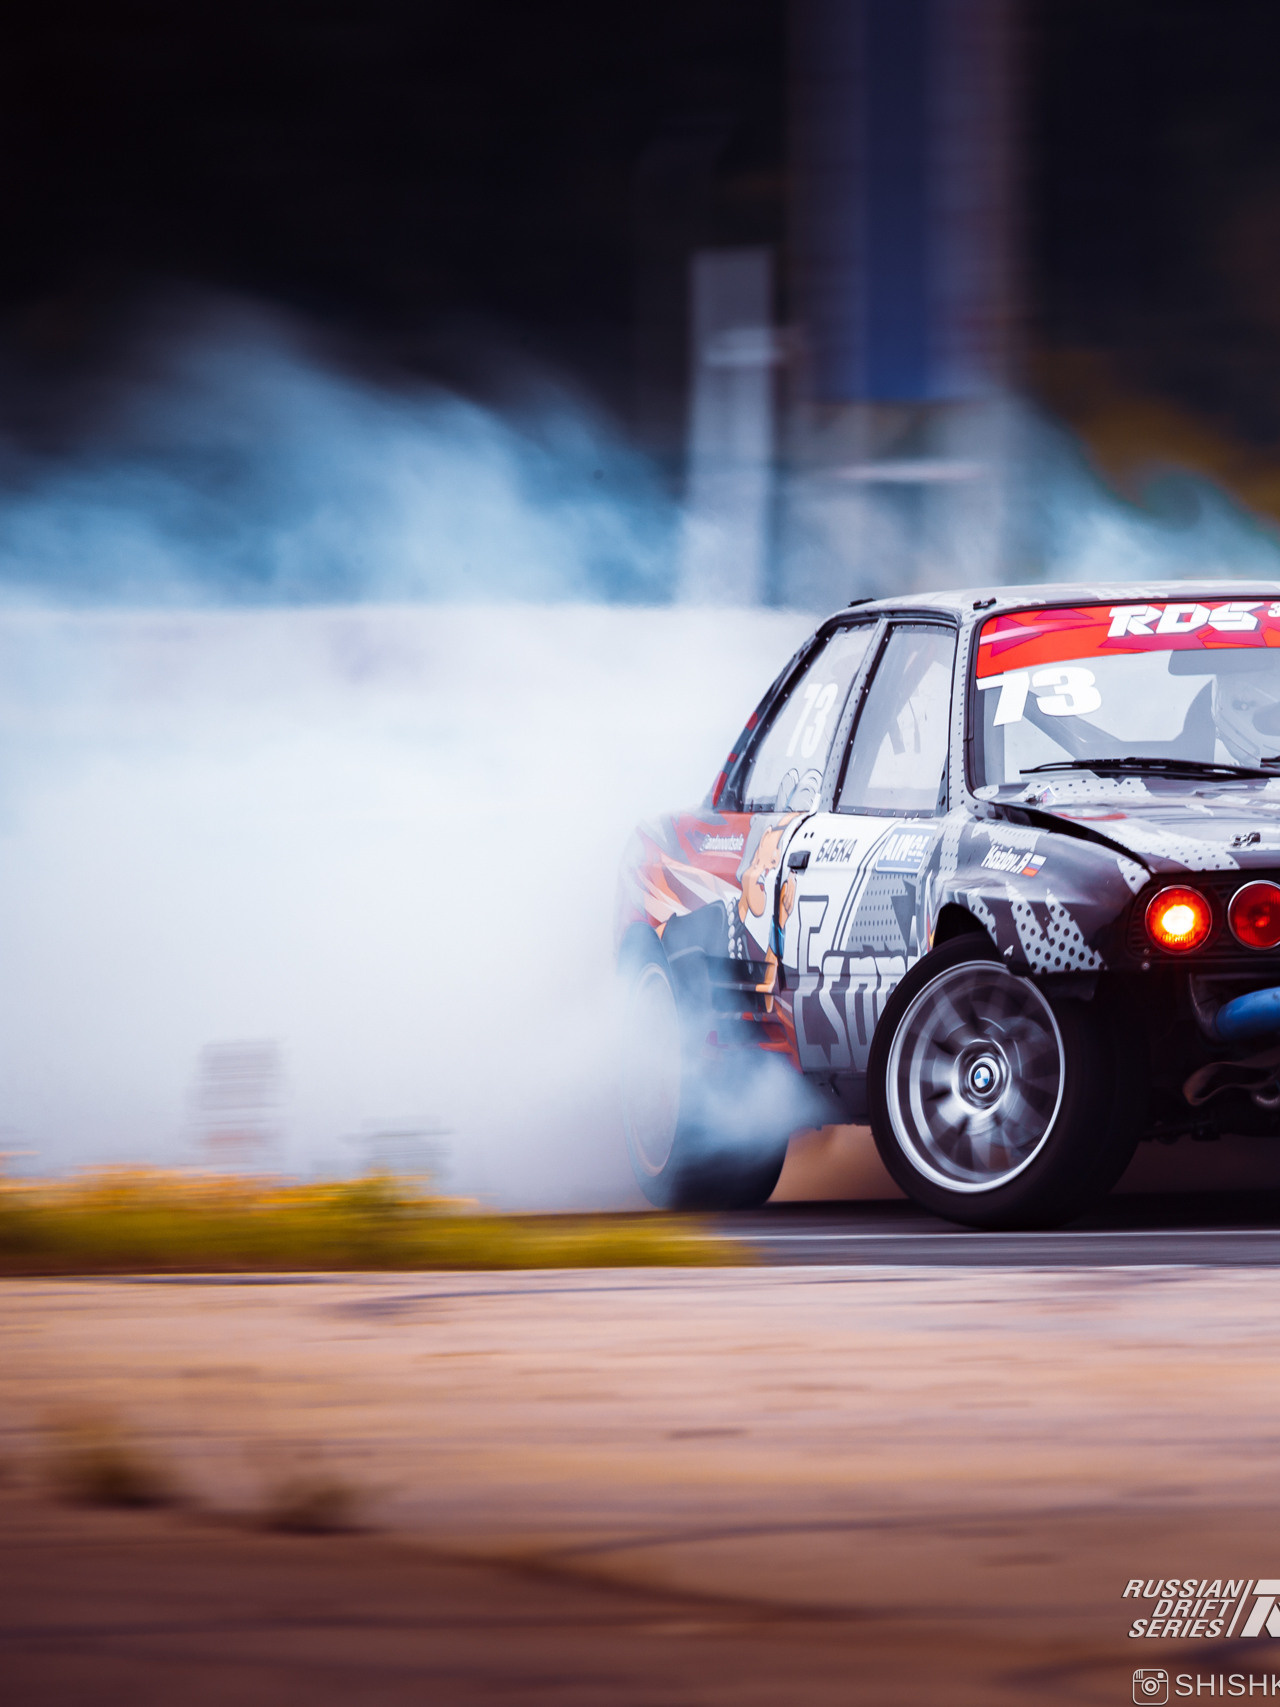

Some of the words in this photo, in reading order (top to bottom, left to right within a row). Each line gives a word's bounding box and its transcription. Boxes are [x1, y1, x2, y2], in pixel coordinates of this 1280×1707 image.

[1107, 601, 1267, 638] RDS
[786, 683, 839, 758] 73
[976, 667, 1102, 727] 73
[816, 838, 858, 863] БАБКА
